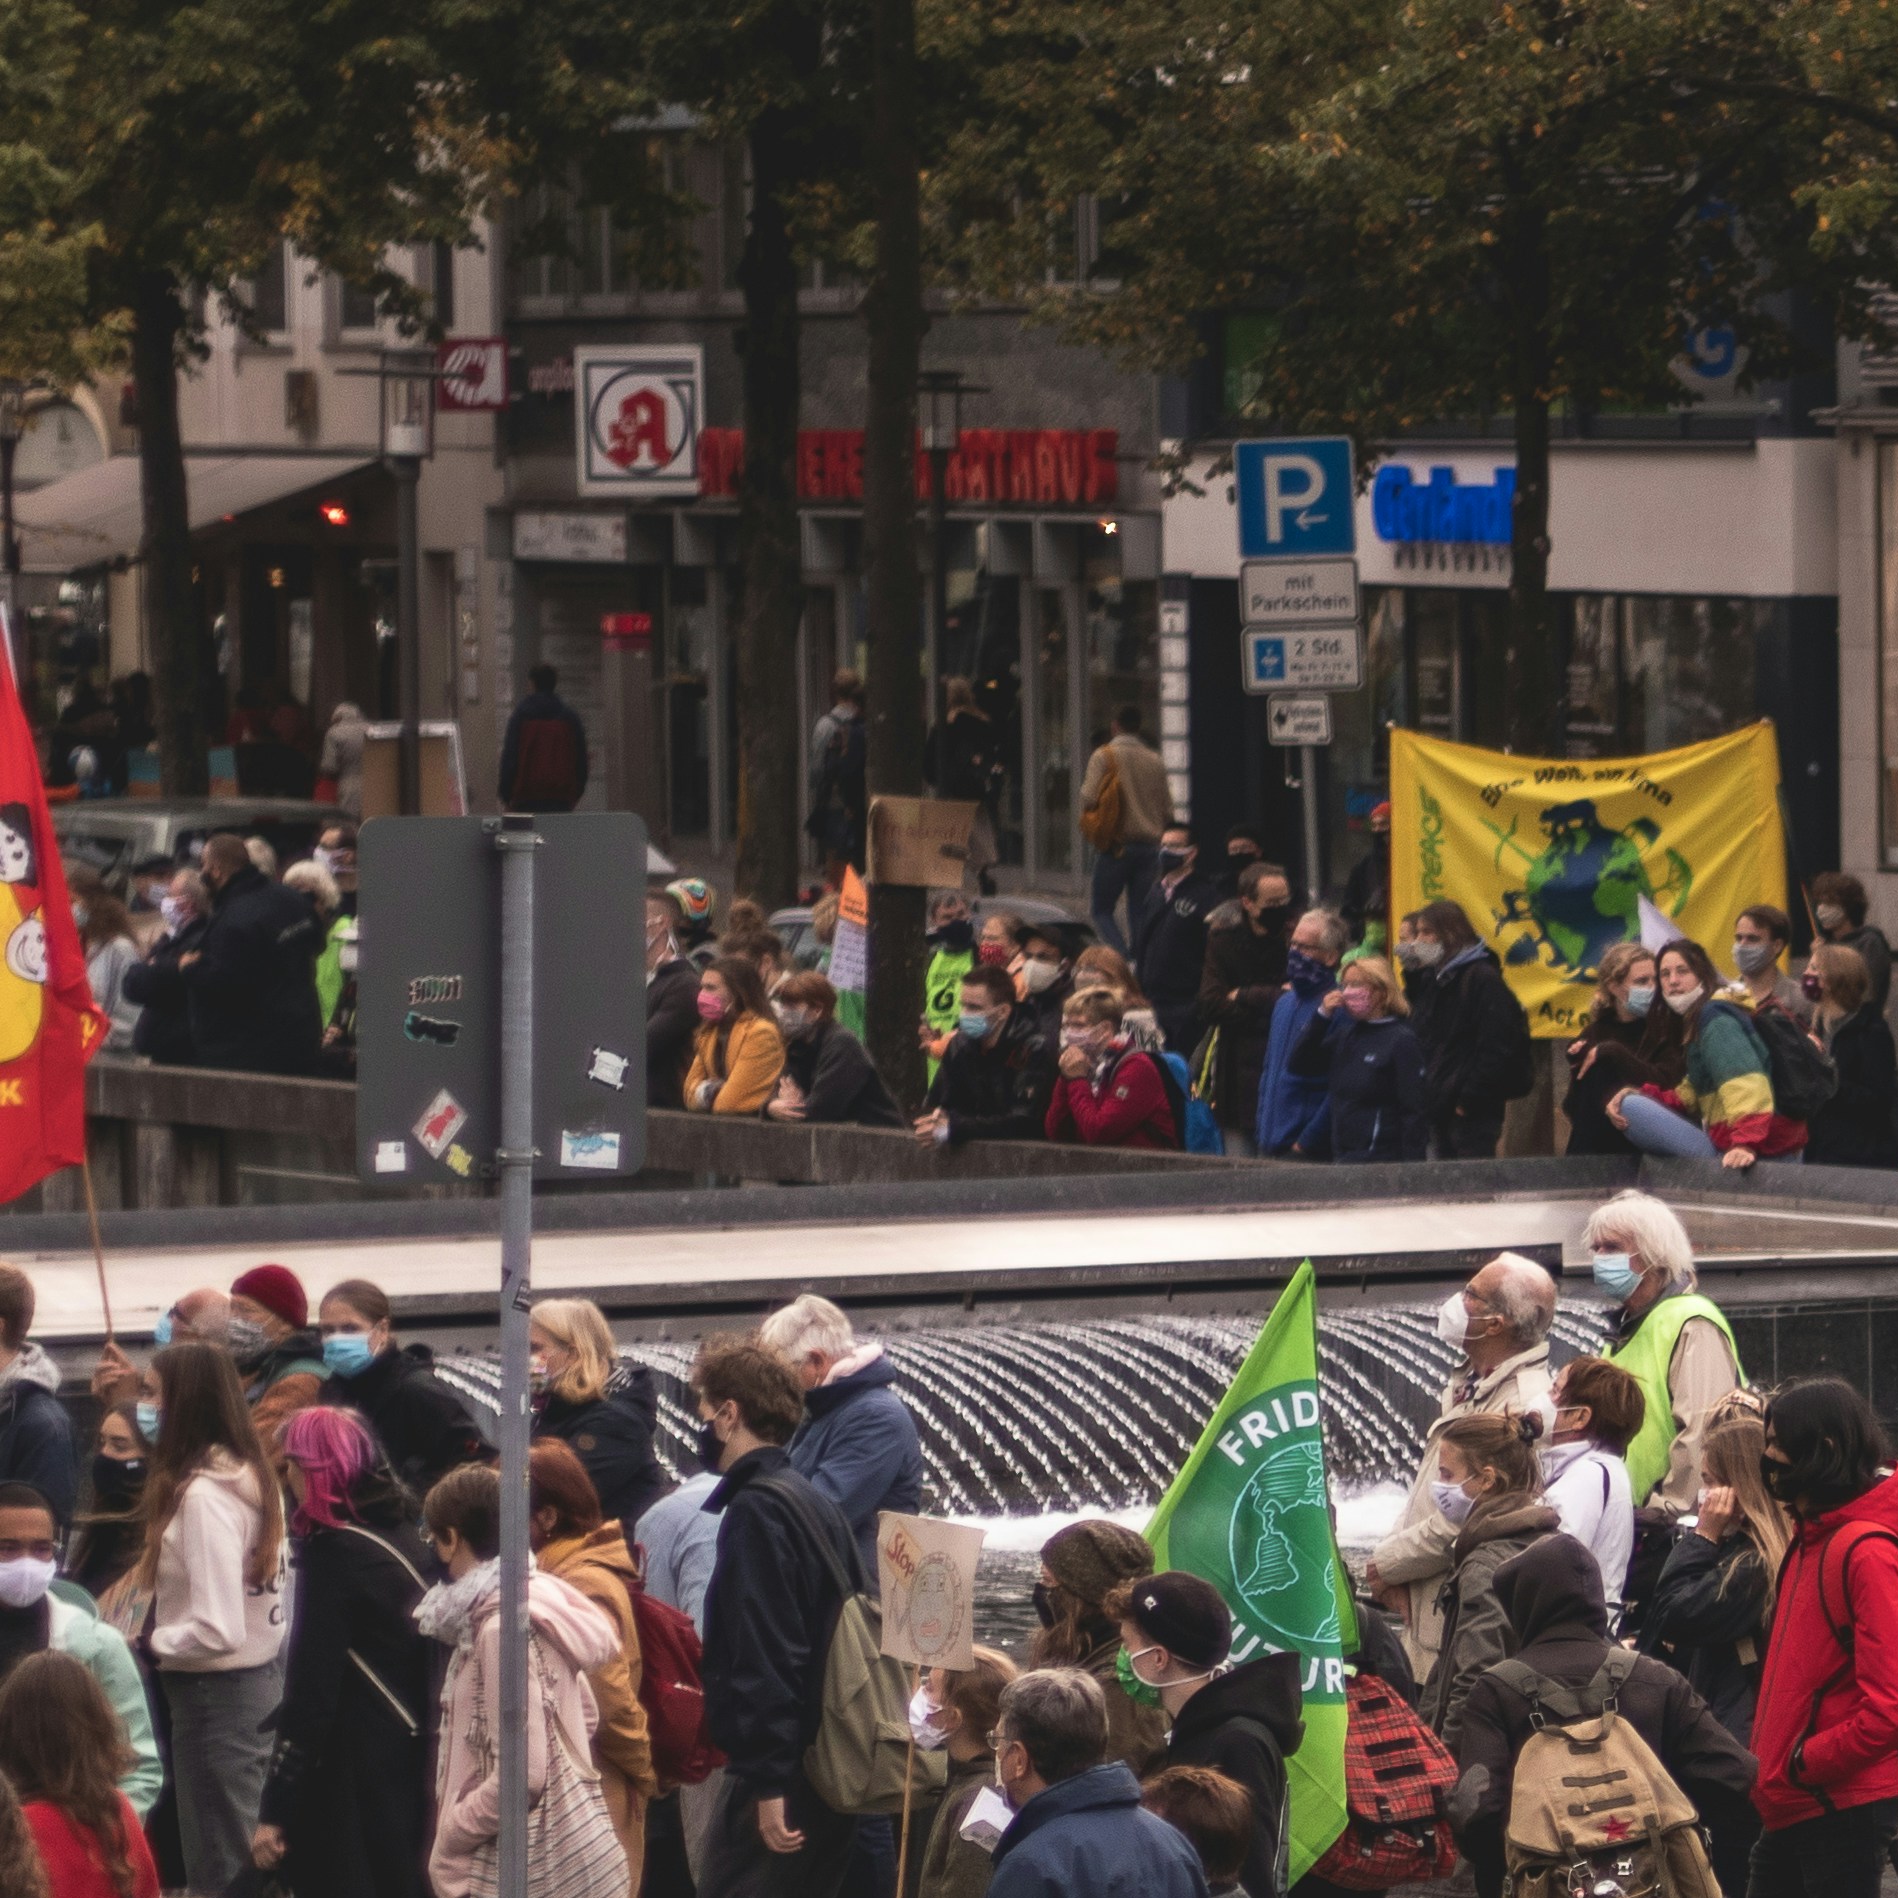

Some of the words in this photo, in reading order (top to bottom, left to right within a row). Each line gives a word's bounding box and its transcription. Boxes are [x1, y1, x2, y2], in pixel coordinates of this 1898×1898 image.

[1263, 455, 1327, 544] P
[1284, 573, 1315, 590] mit
[1251, 592, 1349, 612] Parkschein
[1294, 638, 1306, 656] 2
[1216, 1391, 1320, 1467] FRID
[887, 1532, 915, 1578] Stop
